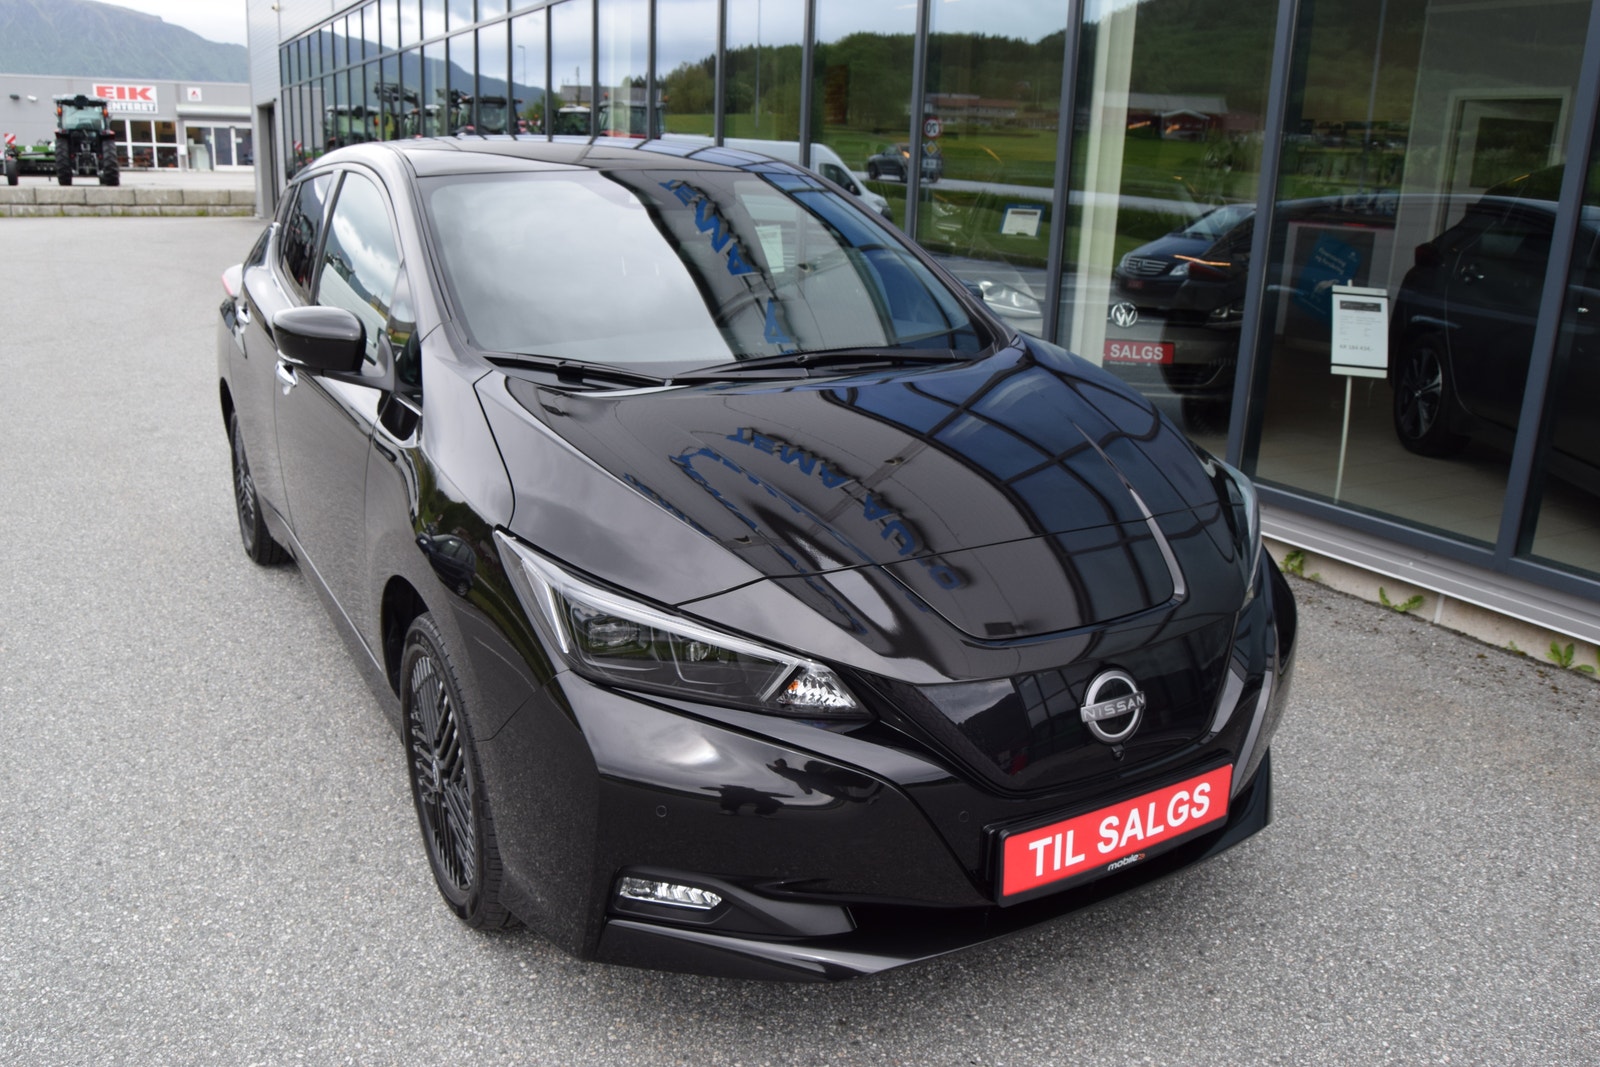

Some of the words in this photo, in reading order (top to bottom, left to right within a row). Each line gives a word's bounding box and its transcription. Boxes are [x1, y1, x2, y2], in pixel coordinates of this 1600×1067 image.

[96, 85, 153, 101] EIK
[106, 101, 156, 112] ENTERET
[1110, 343, 1164, 361] SALGS
[1083, 693, 1146, 721] NISSAN
[1028, 829, 1085, 877] TIL
[1097, 782, 1211, 854] SALGS
